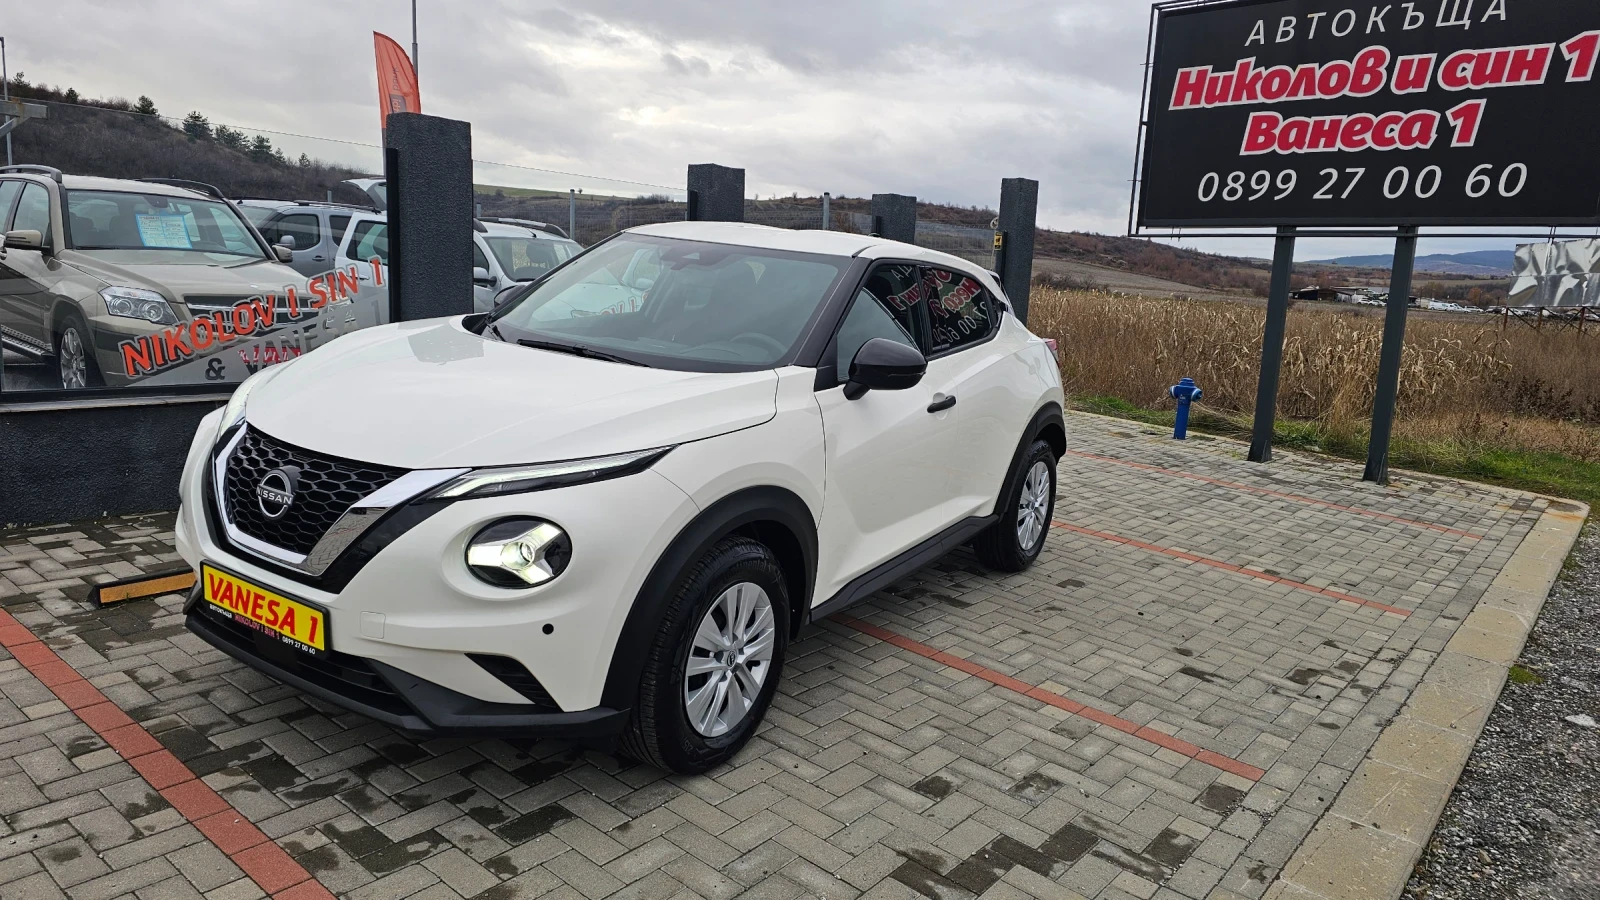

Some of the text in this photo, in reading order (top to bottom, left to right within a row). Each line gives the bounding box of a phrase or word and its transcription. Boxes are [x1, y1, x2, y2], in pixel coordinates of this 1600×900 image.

[1244, 0, 1508, 47] АВТОКЪЩА
[1168, 30, 1600, 111] Николов и син 1
[1239, 98, 1487, 156] Ванеса 1
[1197, 162, 1528, 203] 0899 27 00 60
[119, 293, 276, 378] NIKOLOV
[308, 265, 361, 310] SIN
[205, 357, 226, 381] &
[256, 483, 293, 505] NISSAN
[208, 572, 319, 645] VANESA 1
[281, 635, 294, 646] 0899
